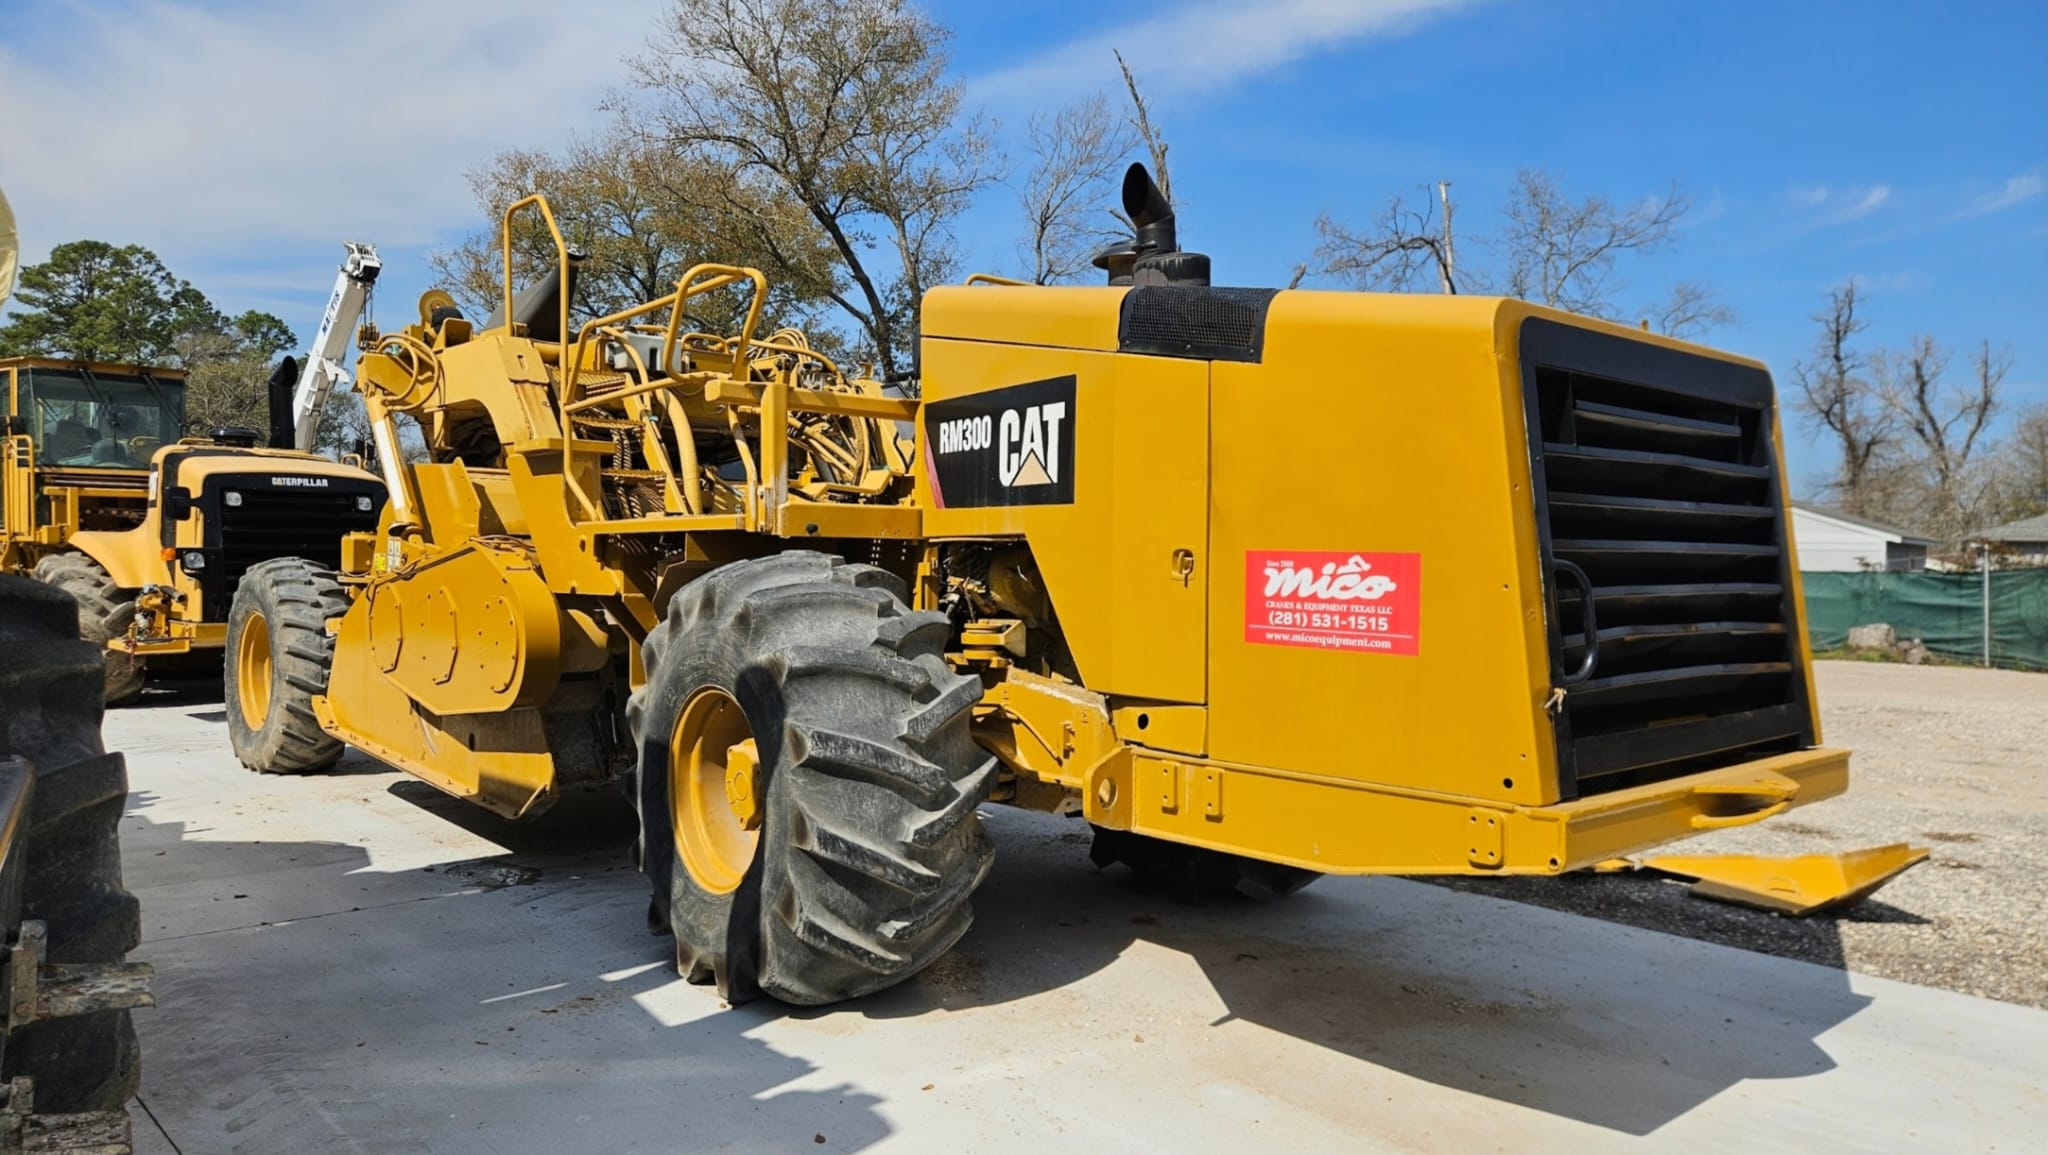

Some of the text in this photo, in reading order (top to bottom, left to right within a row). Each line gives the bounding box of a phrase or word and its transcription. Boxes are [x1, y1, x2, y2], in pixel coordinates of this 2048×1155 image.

[939, 401, 1066, 487] RM300 CAT
[271, 476, 329, 487] CATERPILLAR
[1266, 600, 1393, 615] CRANES & EQUIPMENT TEXAS LLC
[1268, 611, 1389, 631] (281) 531-1515
[1265, 632, 1392, 649] www.micoequipment.com
